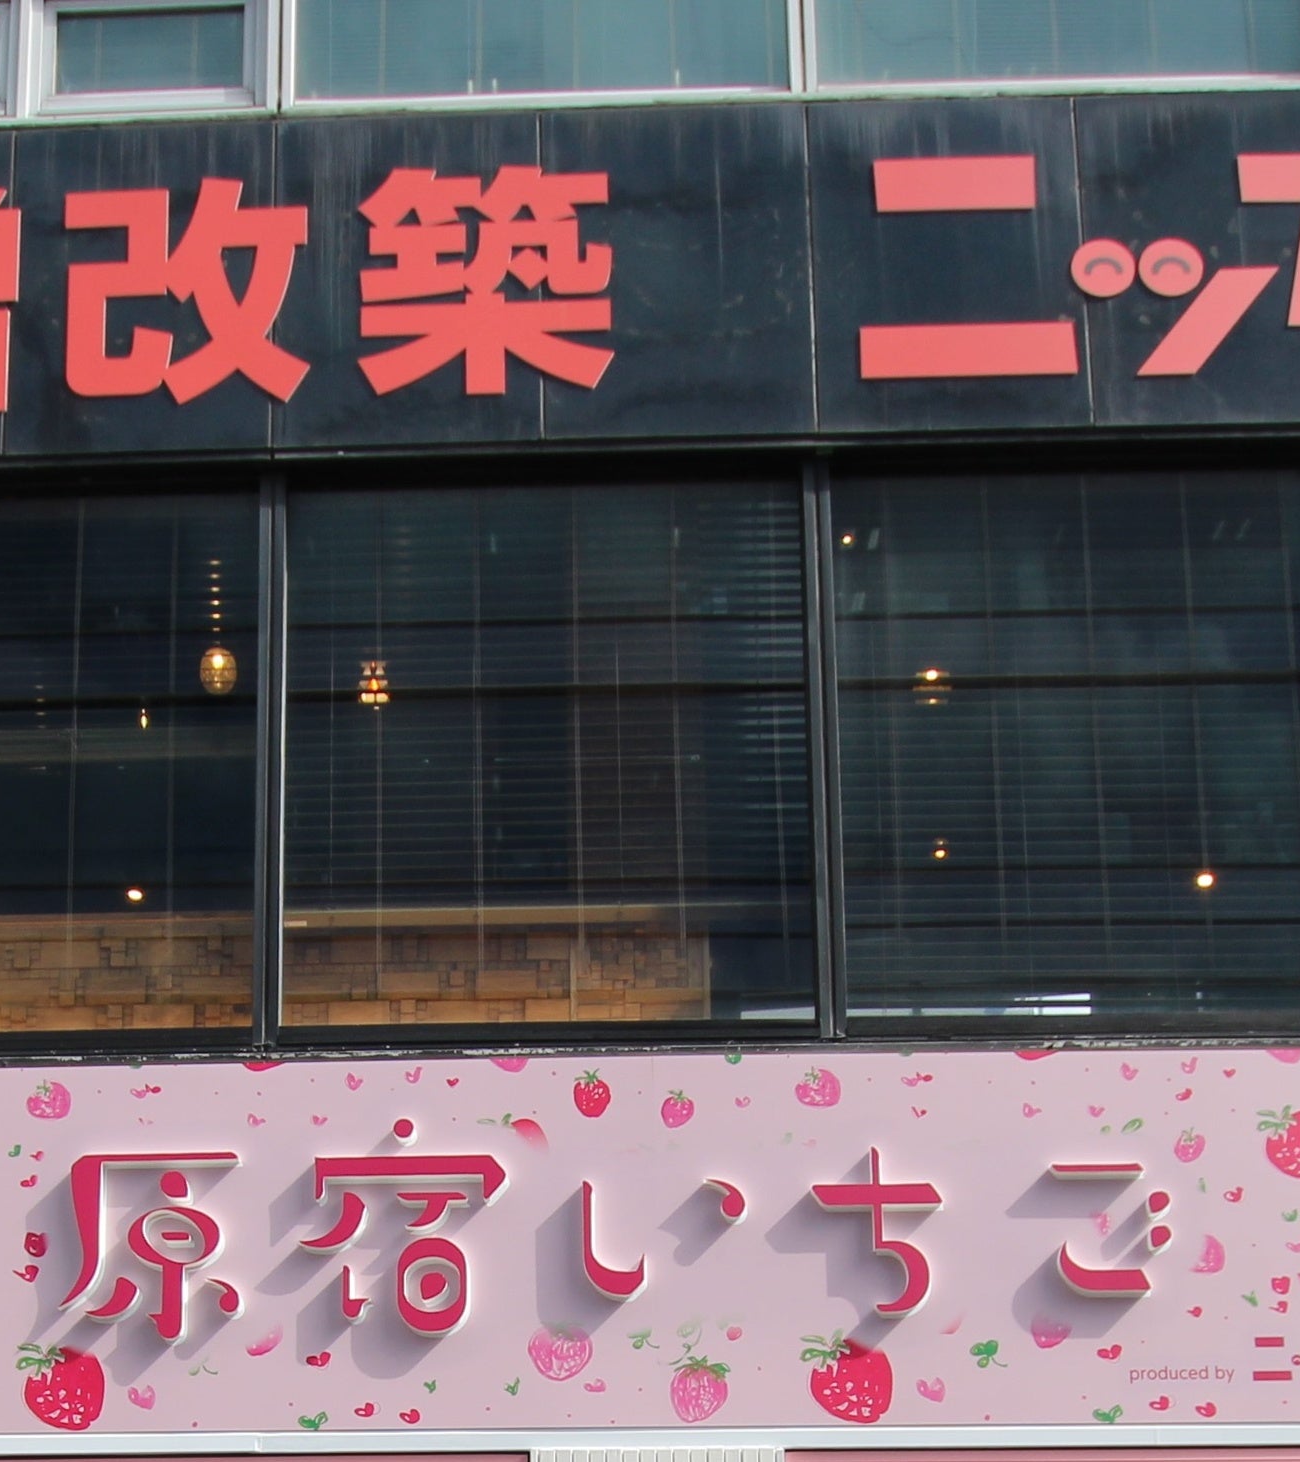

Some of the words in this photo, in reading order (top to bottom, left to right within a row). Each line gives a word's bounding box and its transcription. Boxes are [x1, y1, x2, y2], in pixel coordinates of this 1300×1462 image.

[59, 1117, 1175, 1342] 原宿いちご
[1129, 1365, 1209, 1384] produced
[1215, 1365, 1235, 1384] by
